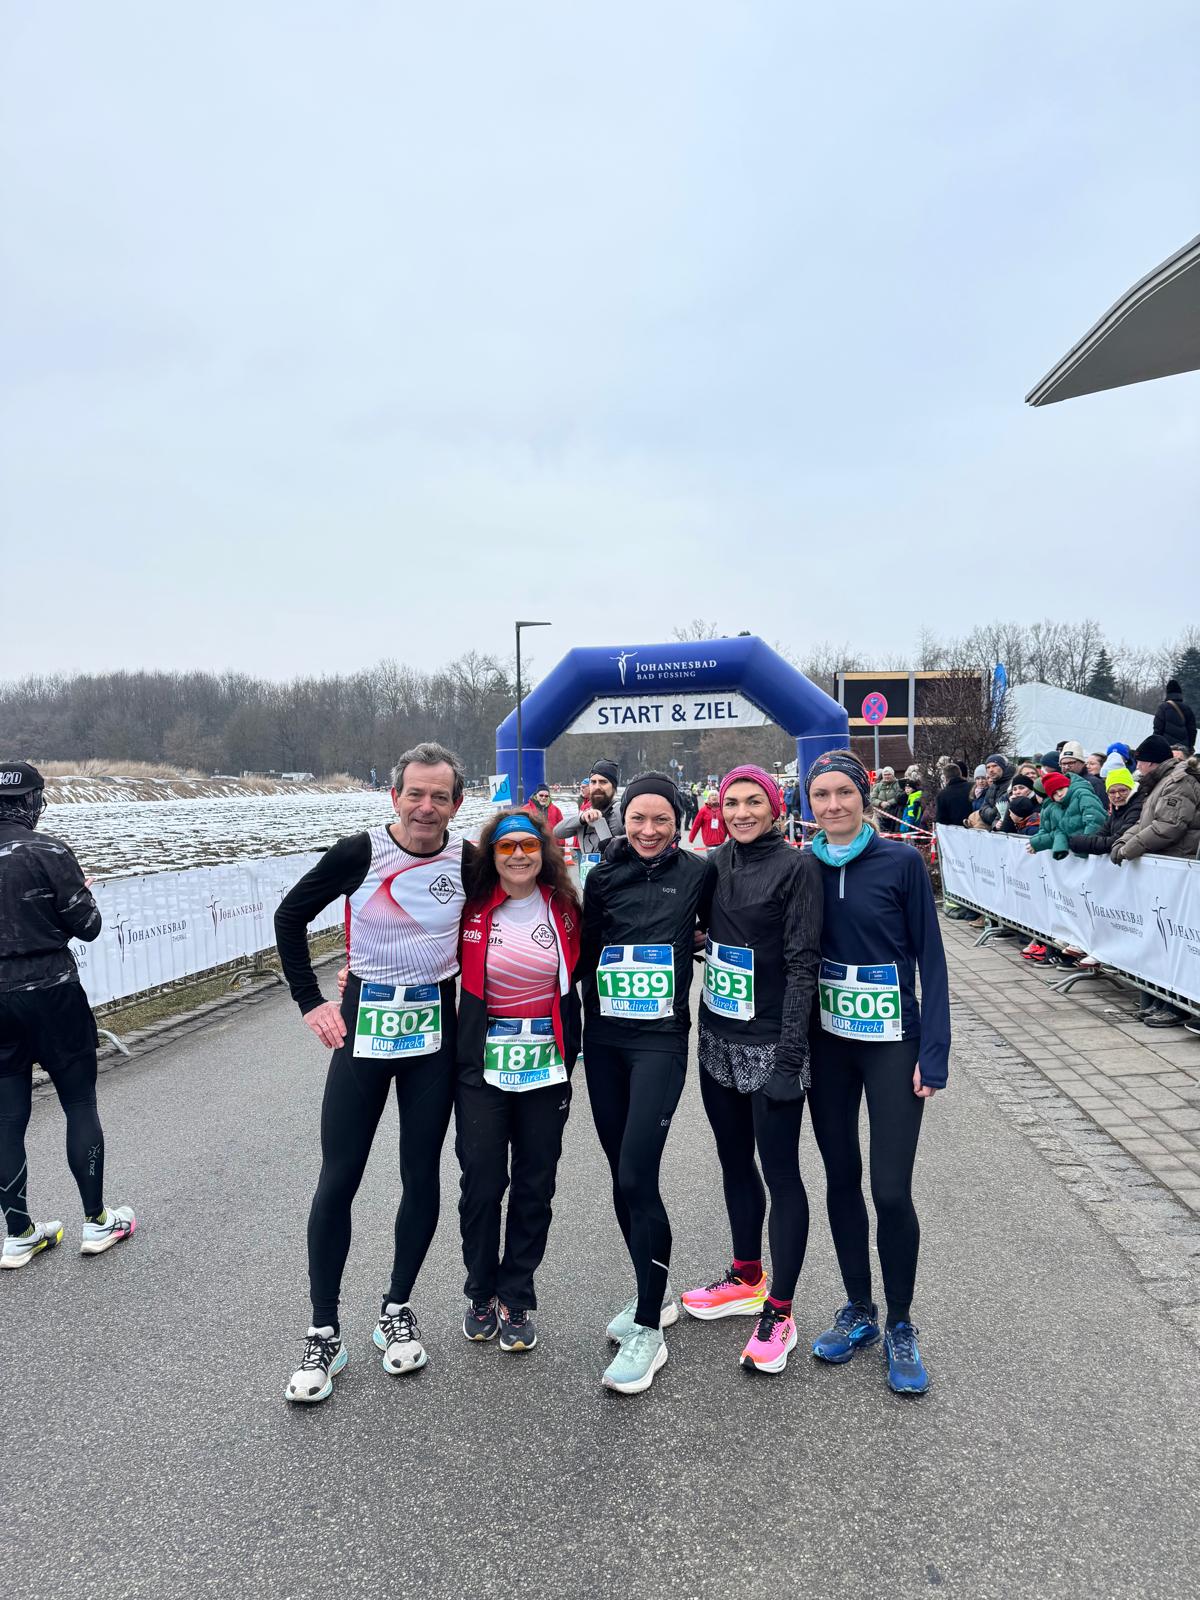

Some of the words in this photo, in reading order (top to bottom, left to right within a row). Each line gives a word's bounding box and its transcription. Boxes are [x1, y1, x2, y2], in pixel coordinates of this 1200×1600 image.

[635, 660, 717, 673] JOHANNESBAD
[658, 671, 697, 679] FÜSSING
[598, 705, 664, 725] START
[671, 704, 687, 722] &
[694, 701, 739, 721] ZIEL
[219, 902, 264, 922] JOHANNESBAD
[127, 920, 187, 944] JOHANNESBAD
[601, 972, 669, 998] 1389
[706, 966, 748, 999] 393
[612, 999, 659, 1012] KURdirekt
[824, 988, 896, 1019] 1606
[365, 1008, 435, 1037] 1802
[832, 1015, 884, 1033] KURdirekt
[372, 1036, 425, 1051] KURdirekt
[491, 1043, 556, 1071] 1811
[500, 1070, 550, 1084] KURdirekt
